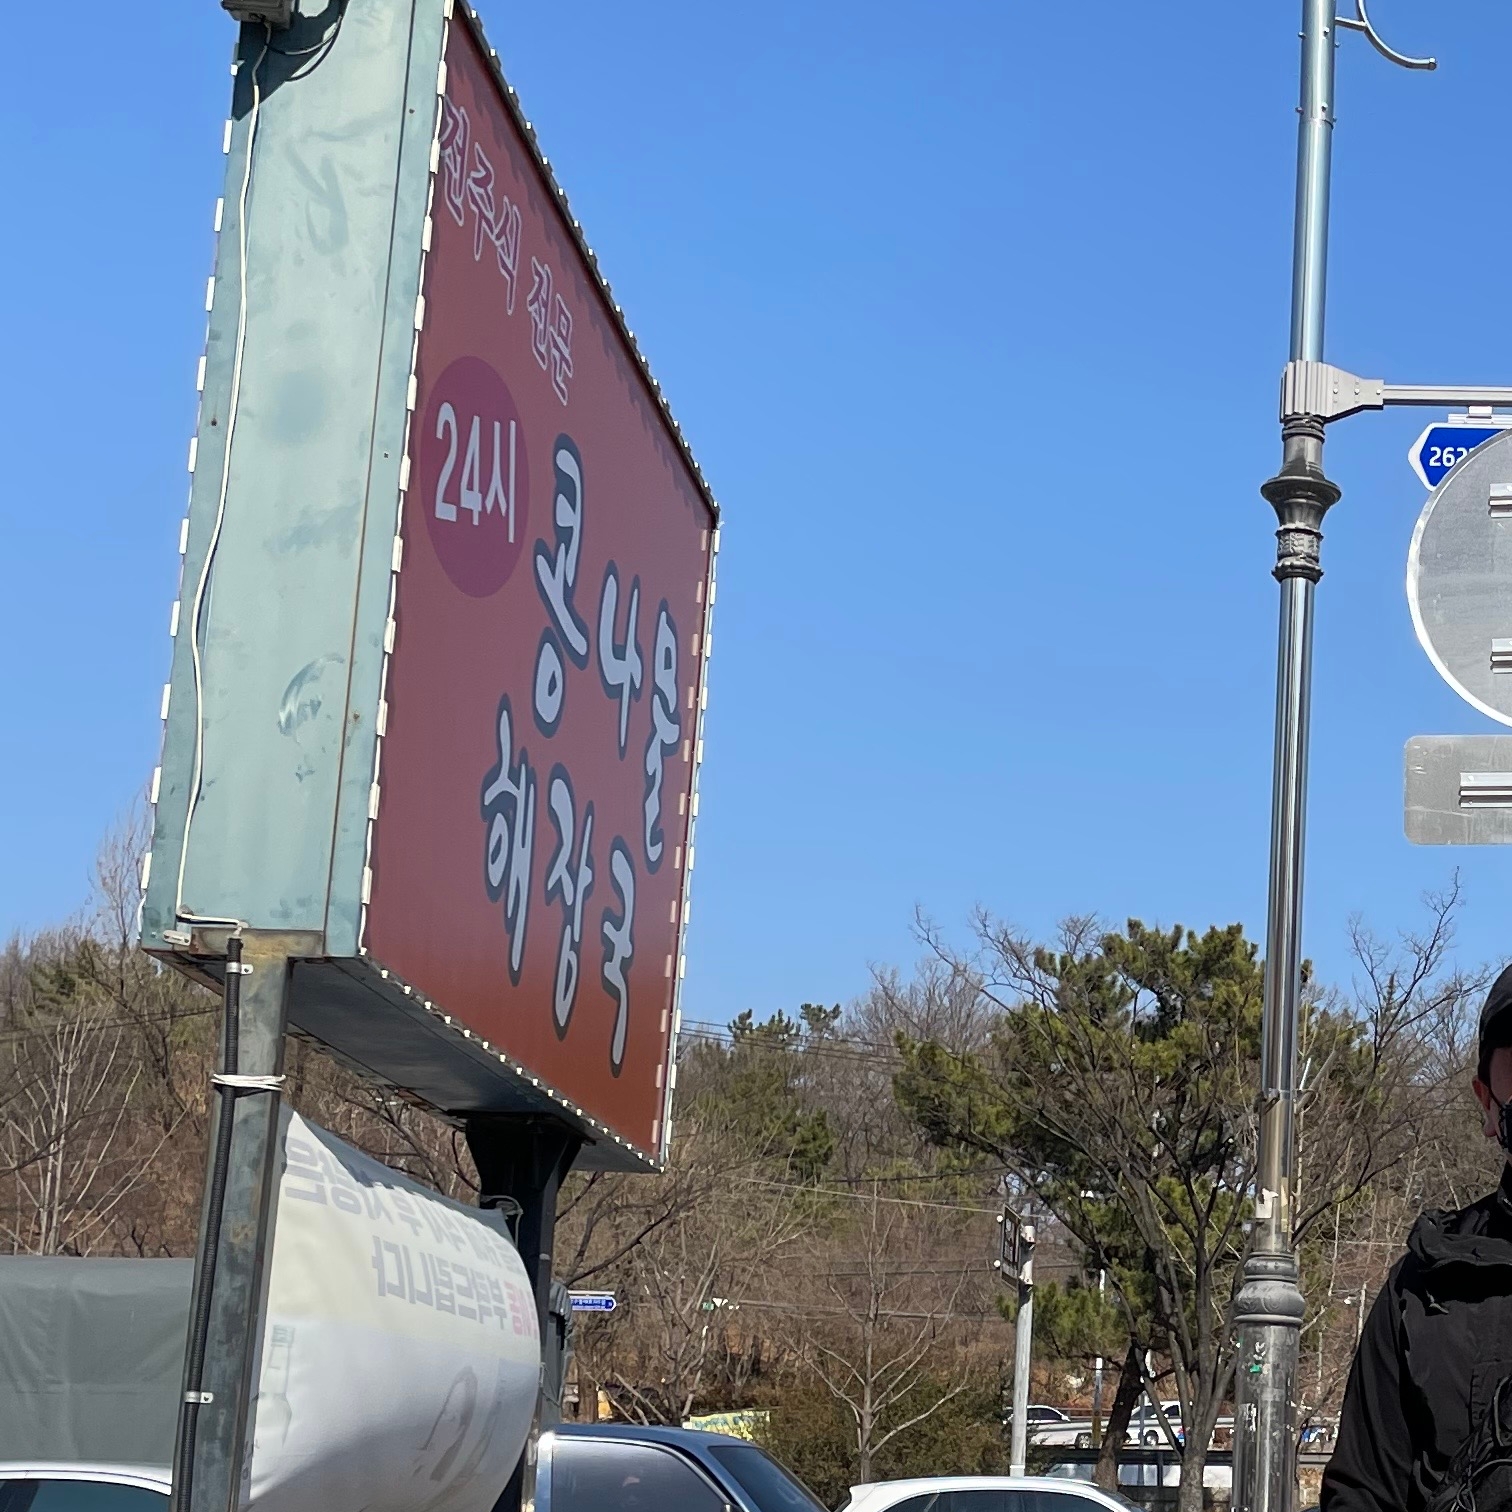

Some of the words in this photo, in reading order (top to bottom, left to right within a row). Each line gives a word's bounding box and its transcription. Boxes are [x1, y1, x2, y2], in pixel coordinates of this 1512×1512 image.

[438, 93, 522, 316] 전주식
[526, 255, 573, 406] 전문
[434, 402, 518, 544] 24시
[1429, 446, 1475, 467] 262
[534, 434, 679, 872] 콩나물
[481, 694, 638, 1078] 해장국
